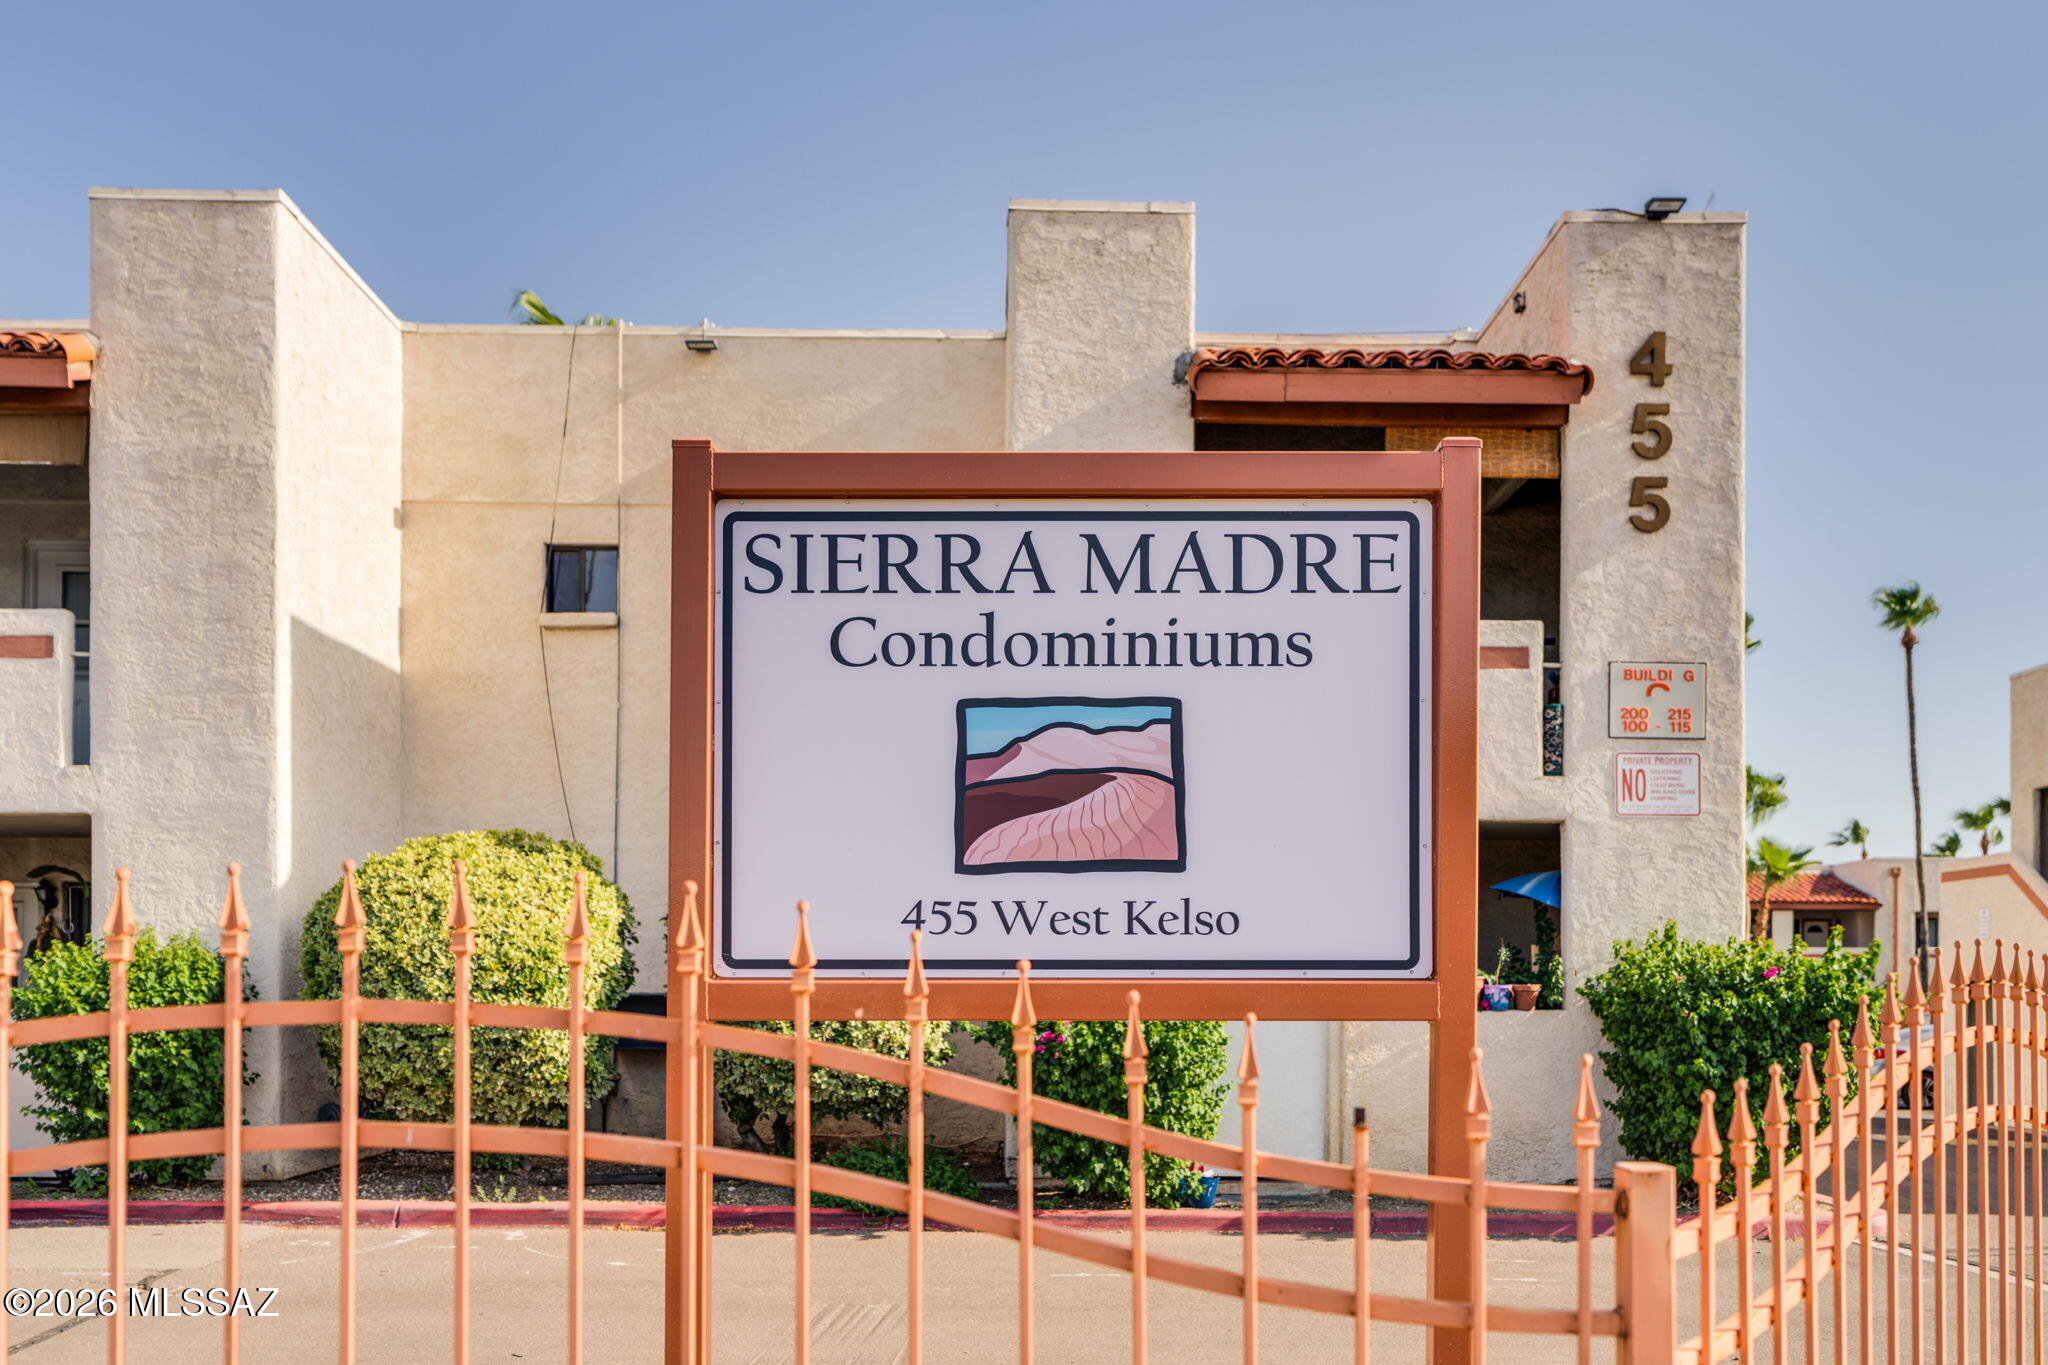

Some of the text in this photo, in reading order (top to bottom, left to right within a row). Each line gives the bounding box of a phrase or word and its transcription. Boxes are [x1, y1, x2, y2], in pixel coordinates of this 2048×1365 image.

[744, 530, 1402, 595] SIERRA MADRE
[829, 610, 1313, 668] Condominiums
[1621, 707, 1692, 721] 200 215
[1622, 720, 1649, 733] 100
[1670, 721, 1692, 734] 115
[1622, 757, 1693, 766] PRIVATE PROPERTY
[1622, 769, 1646, 802] NO
[900, 897, 1240, 936] 455 West Kelso
